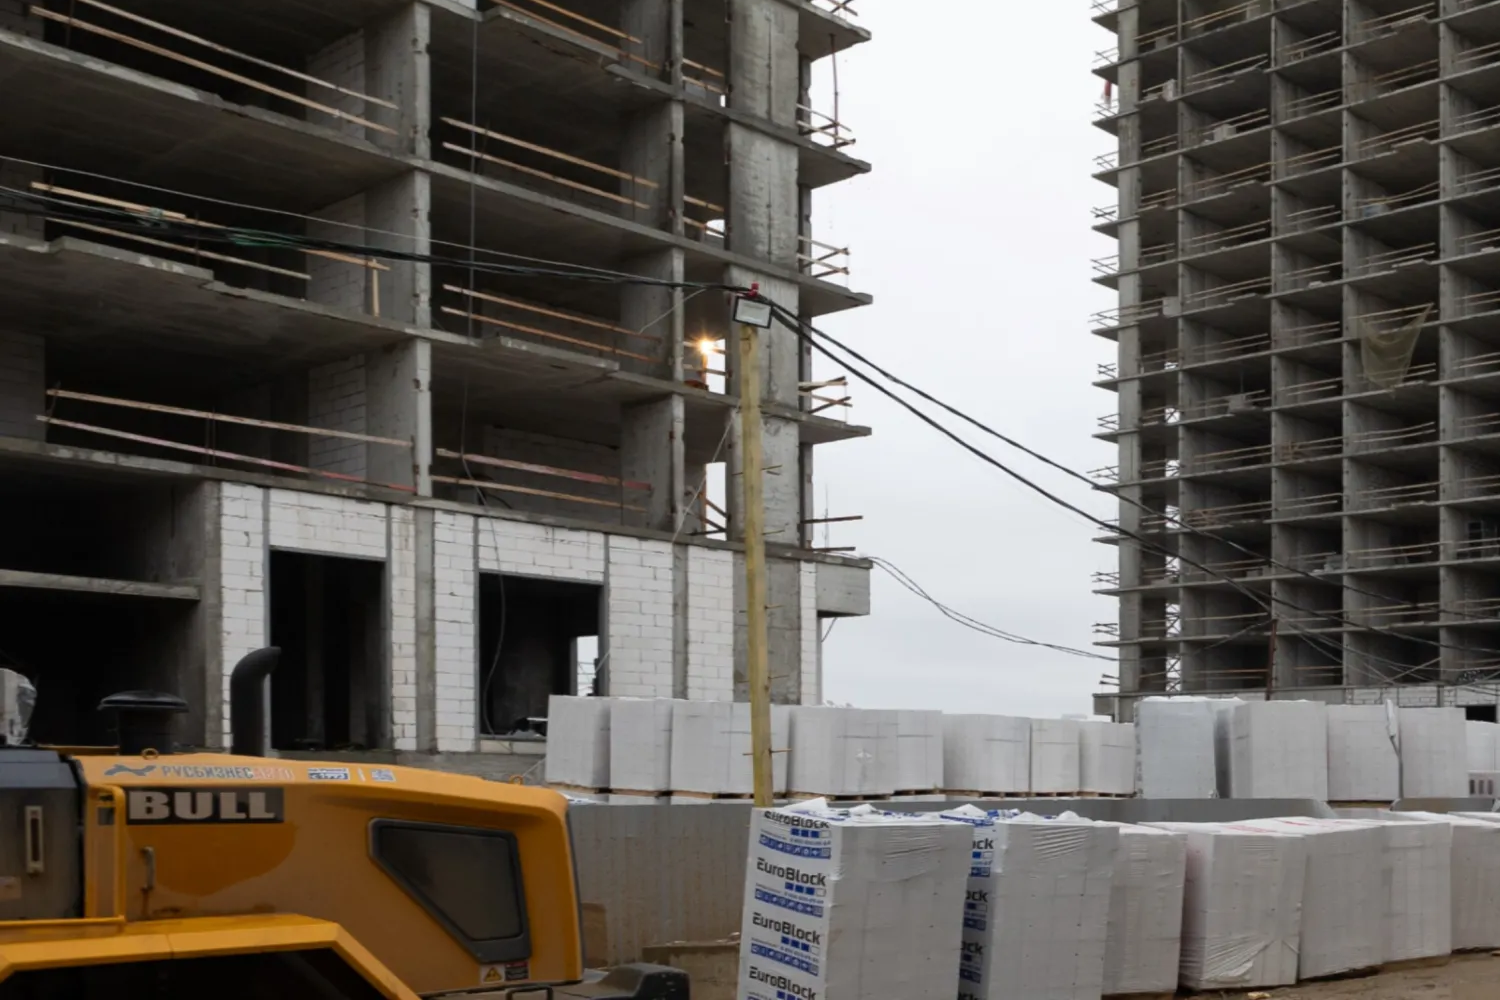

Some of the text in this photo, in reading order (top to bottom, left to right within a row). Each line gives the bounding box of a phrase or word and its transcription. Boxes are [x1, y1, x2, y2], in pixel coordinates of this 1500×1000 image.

[128, 791, 276, 821] BULL
[756, 857, 827, 887] EuroBlock
[752, 911, 821, 945] EuroBlock
[748, 966, 816, 1000] EuroBlock
